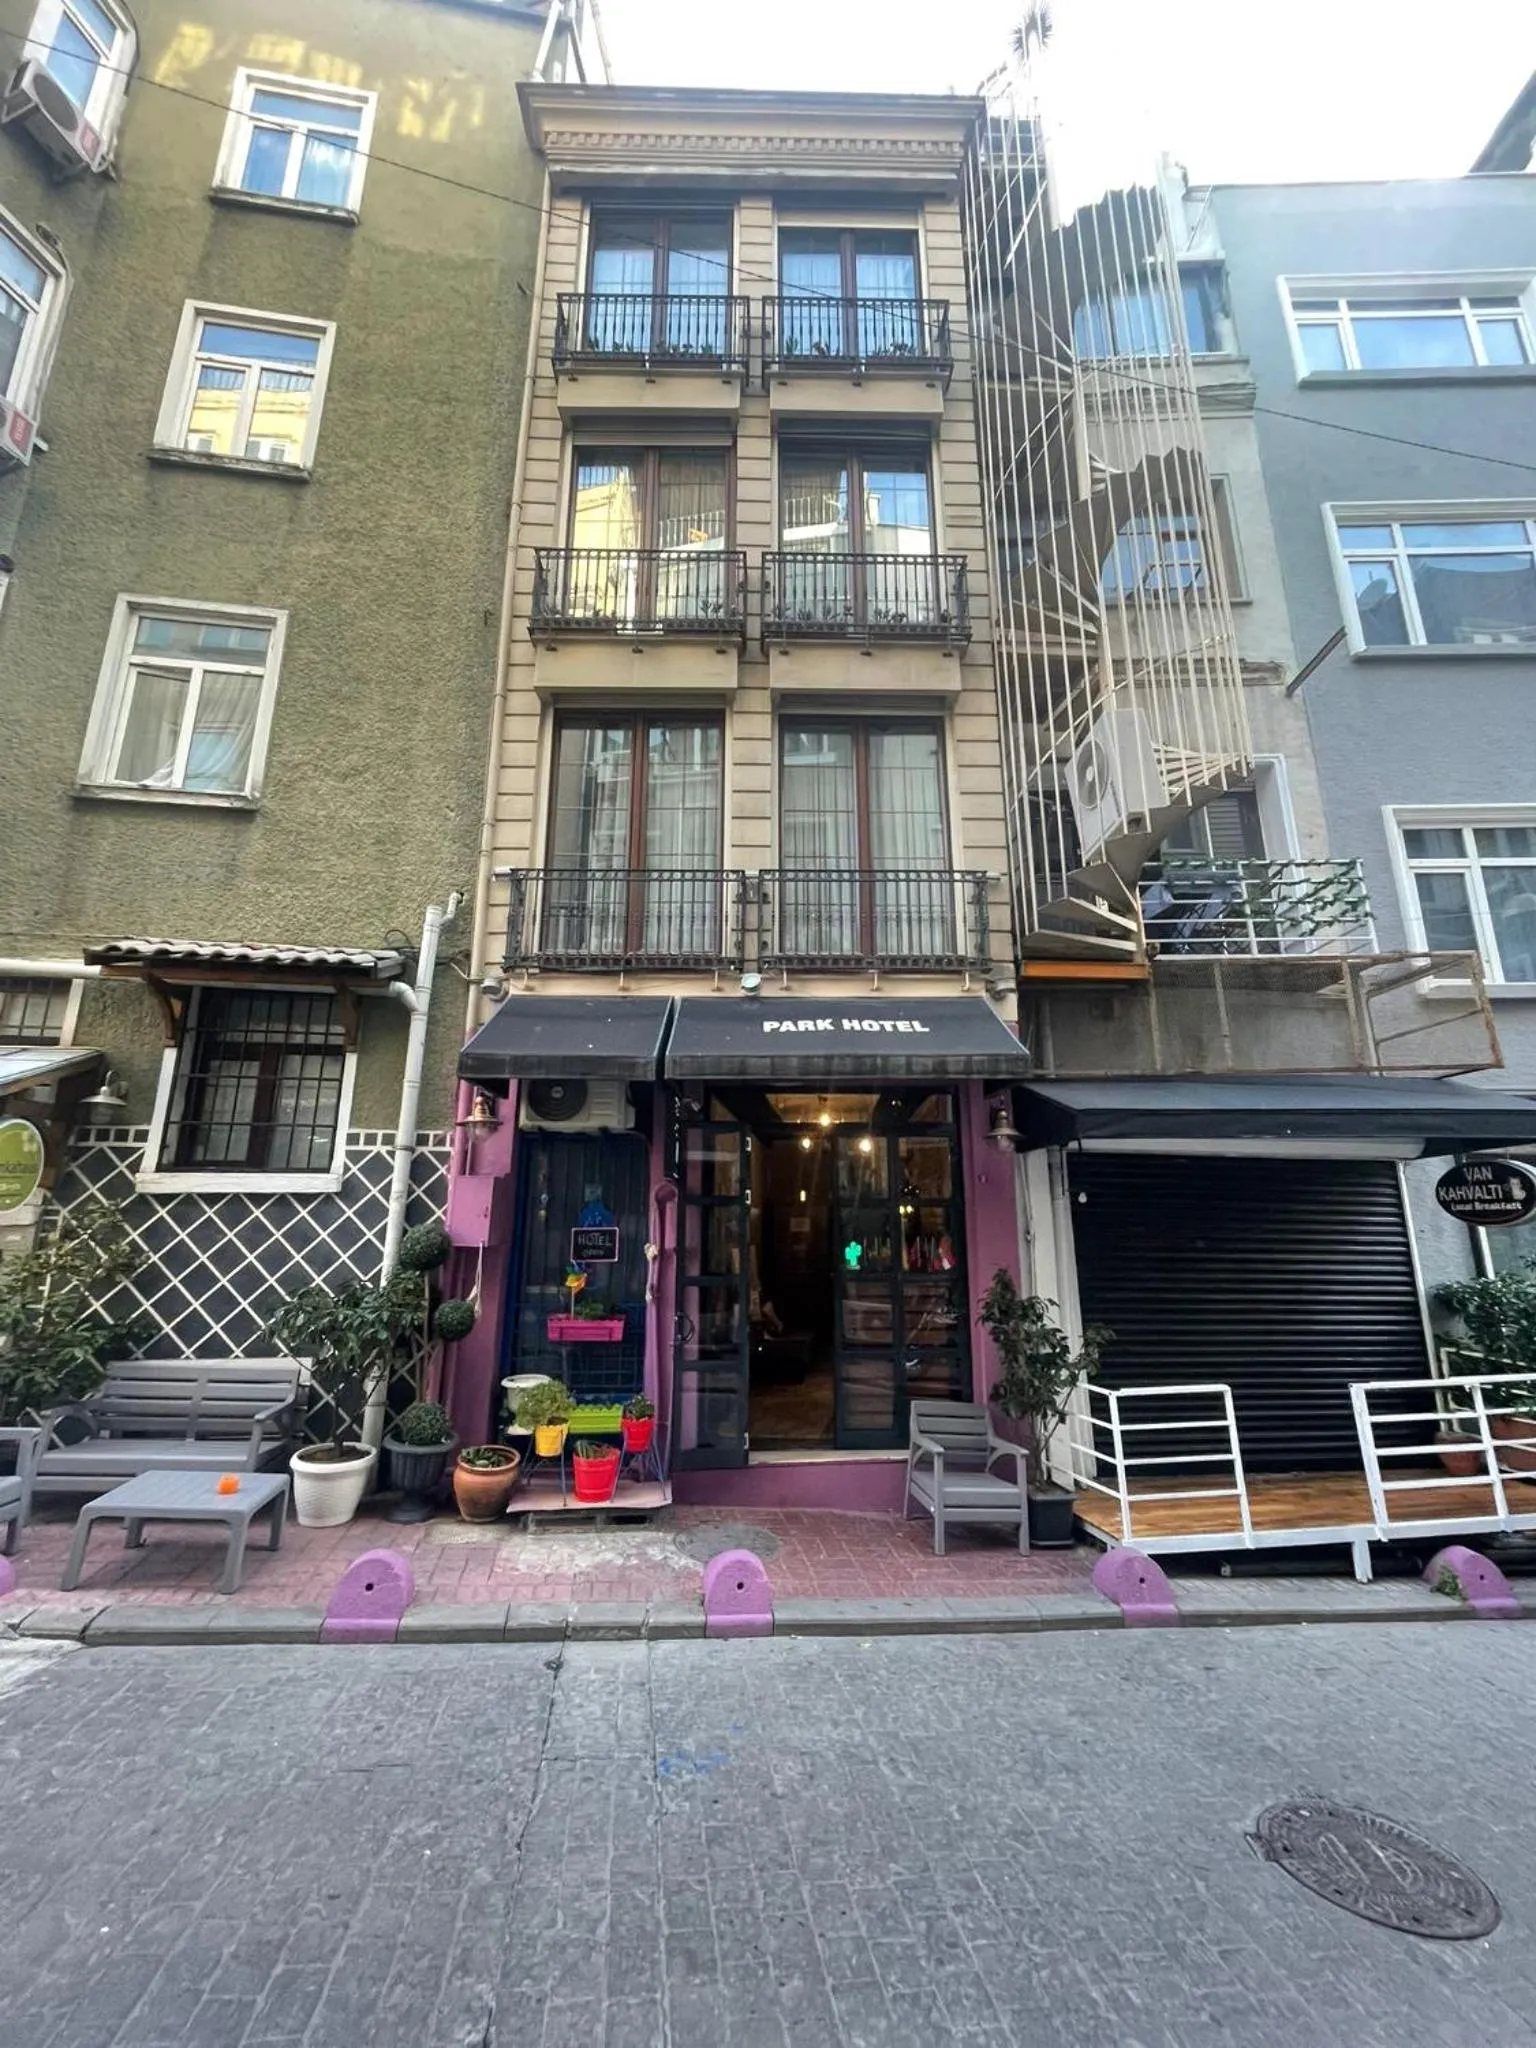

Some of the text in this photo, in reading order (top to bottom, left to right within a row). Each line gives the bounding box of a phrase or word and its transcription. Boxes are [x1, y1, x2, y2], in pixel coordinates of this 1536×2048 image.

[763, 1019, 930, 1033] PARK HOTEL
[1463, 1166, 1493, 1181] VAN
[1438, 1184, 1503, 1201] KAHVALTI
[578, 1232, 613, 1246] HOTEL
